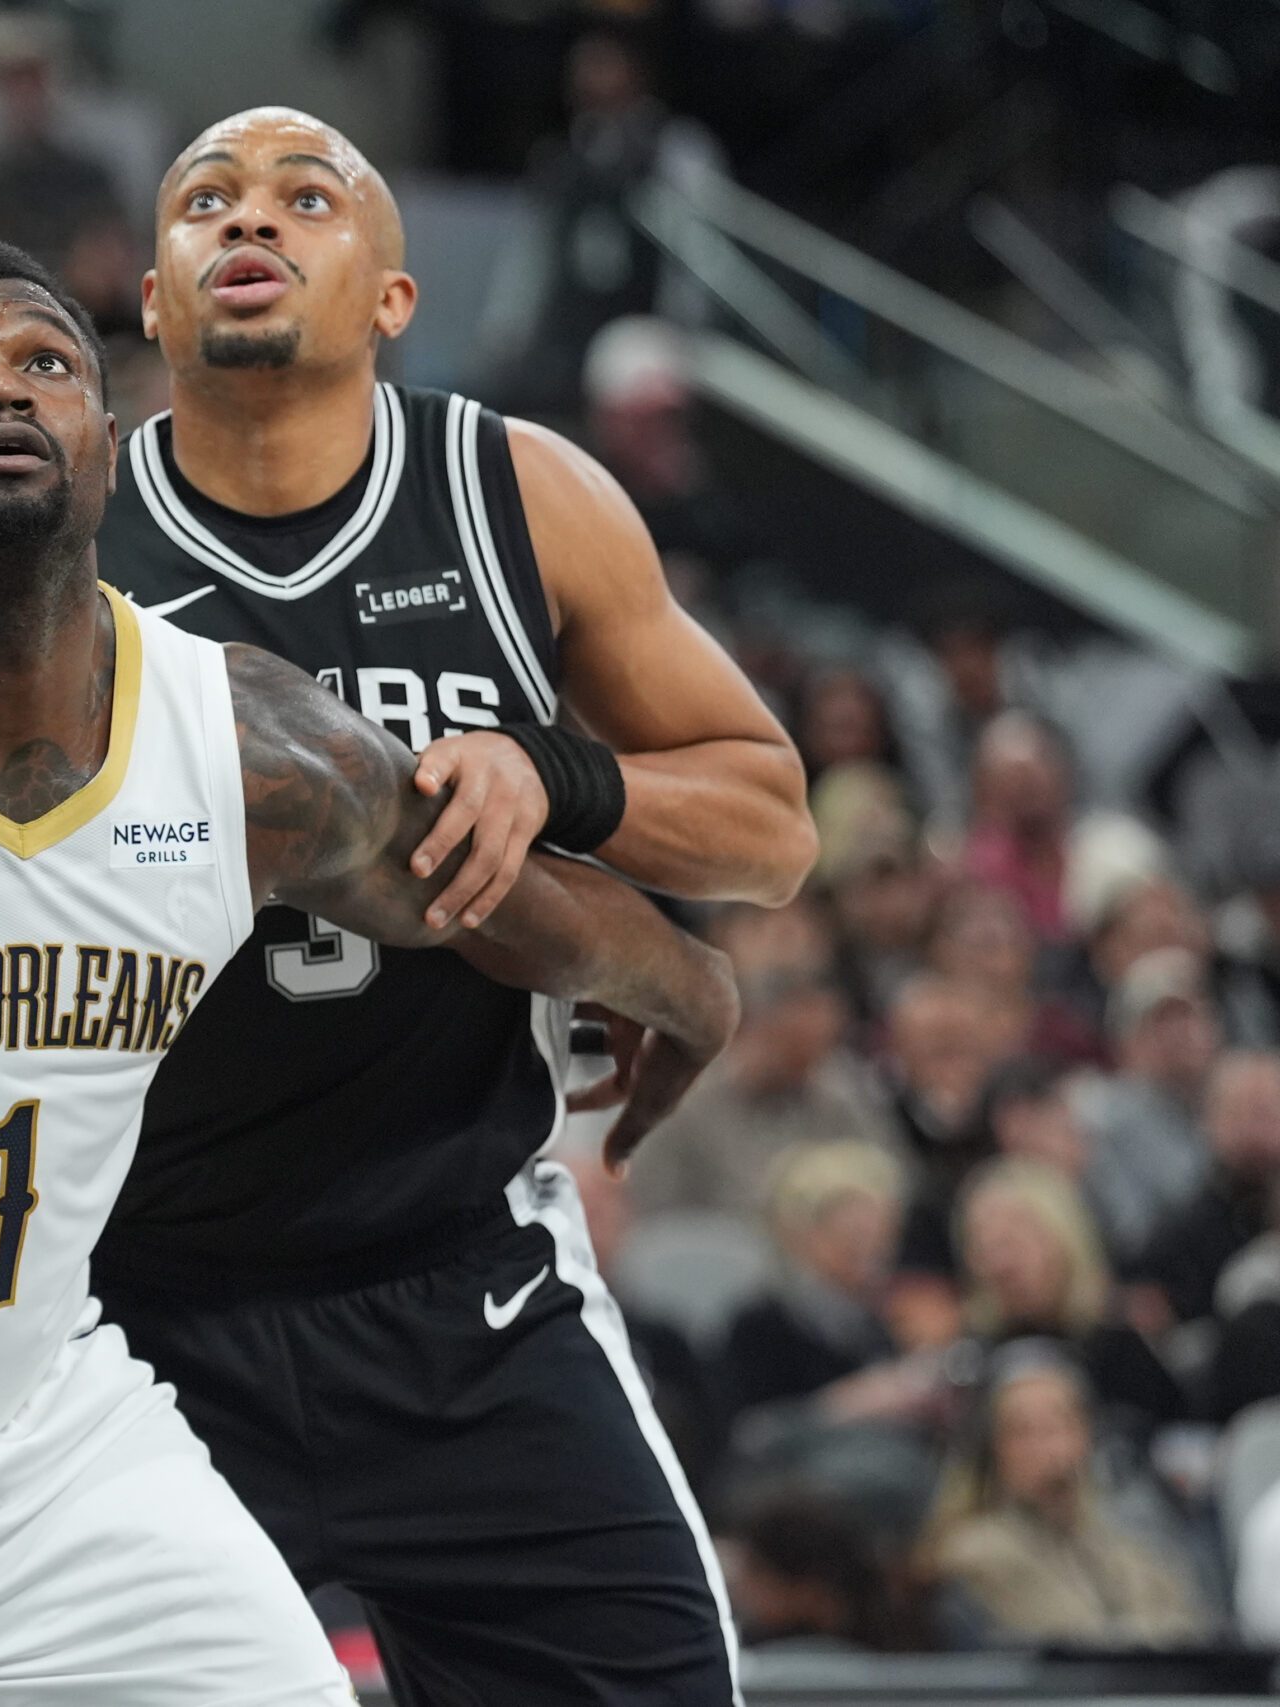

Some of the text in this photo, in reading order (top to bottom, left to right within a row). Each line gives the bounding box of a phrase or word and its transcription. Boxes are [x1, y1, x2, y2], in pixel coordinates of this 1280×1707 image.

[369, 583, 450, 612] LEDGER
[316, 667, 500, 752] RS
[114, 822, 210, 845] NEWAGE
[136, 850, 187, 863] GRILLS
